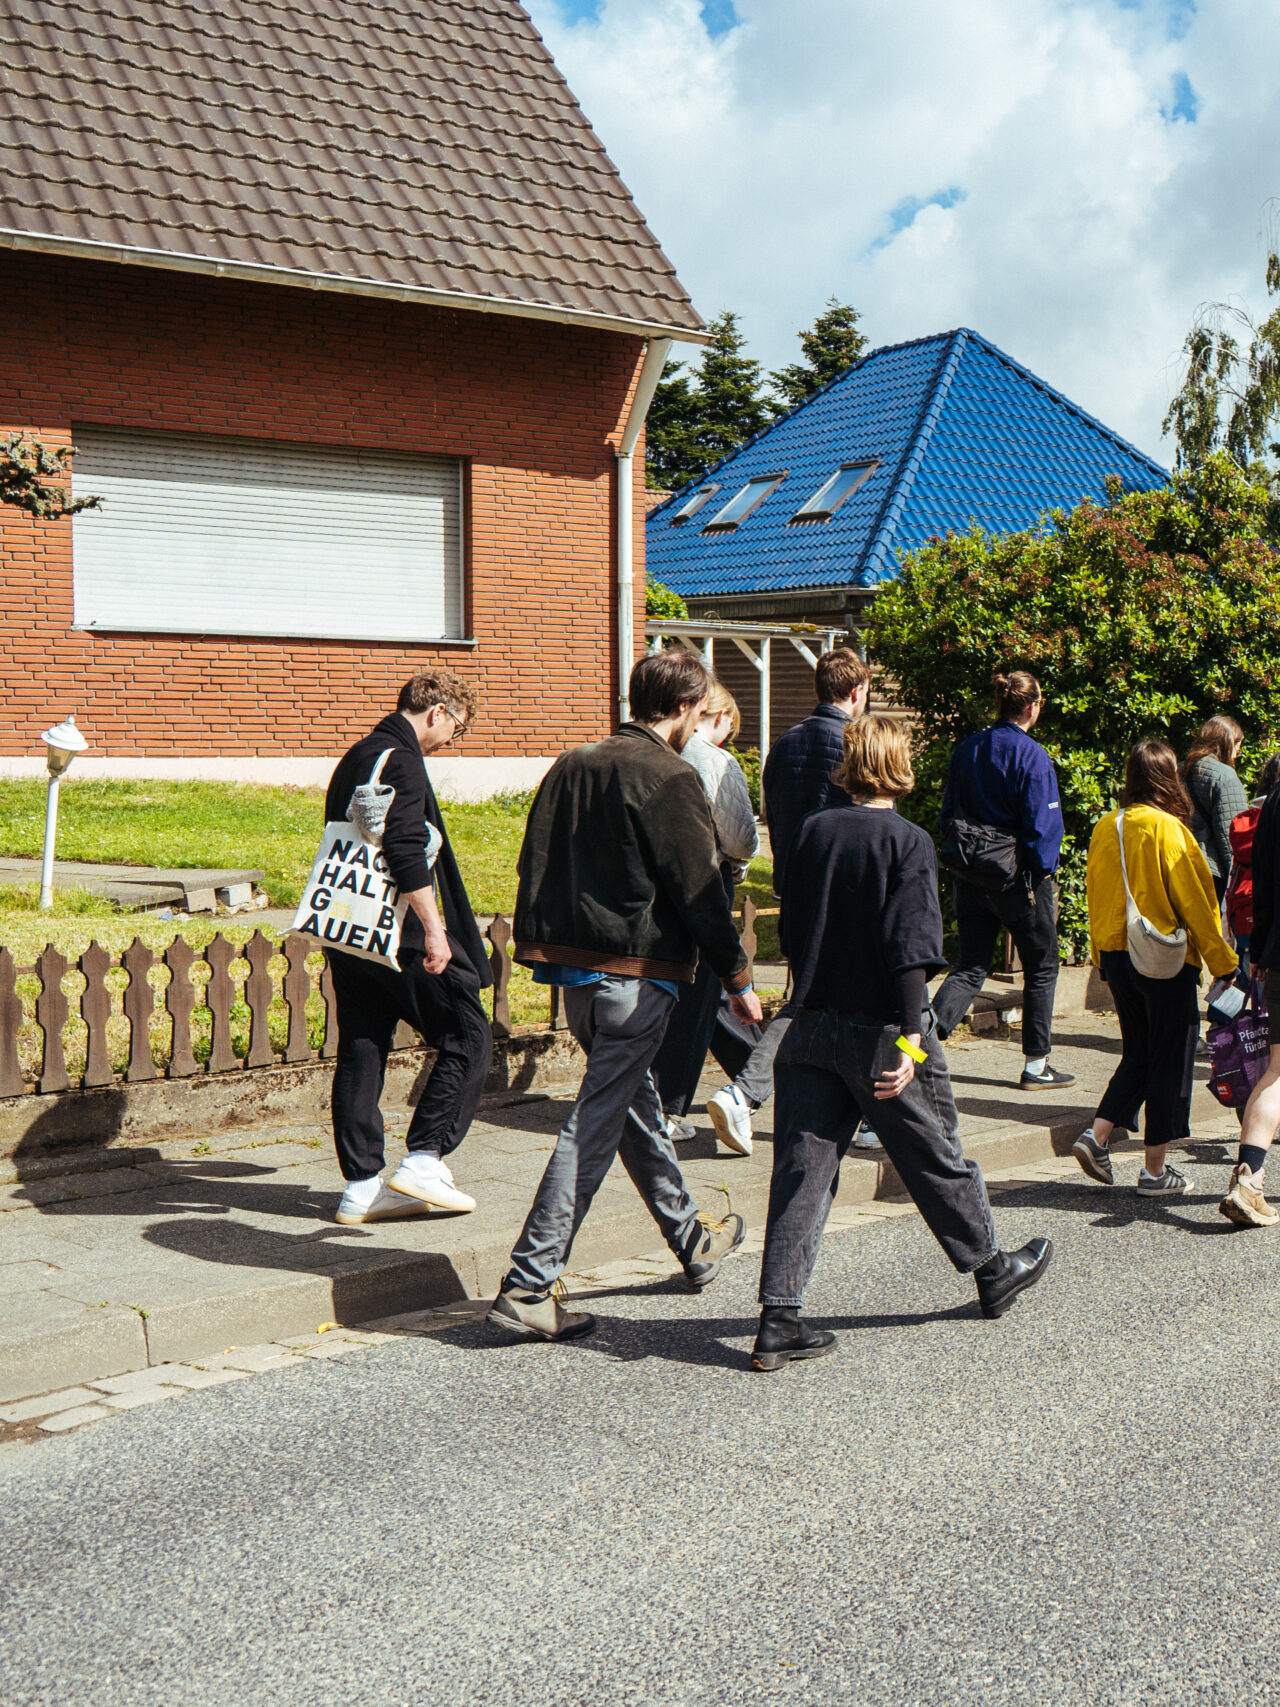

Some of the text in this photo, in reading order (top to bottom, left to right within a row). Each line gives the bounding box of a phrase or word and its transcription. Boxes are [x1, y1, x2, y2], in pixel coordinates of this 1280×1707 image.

[310, 887, 332, 912] G
[376, 904, 395, 931] B
[298, 913, 392, 957] AUEN
